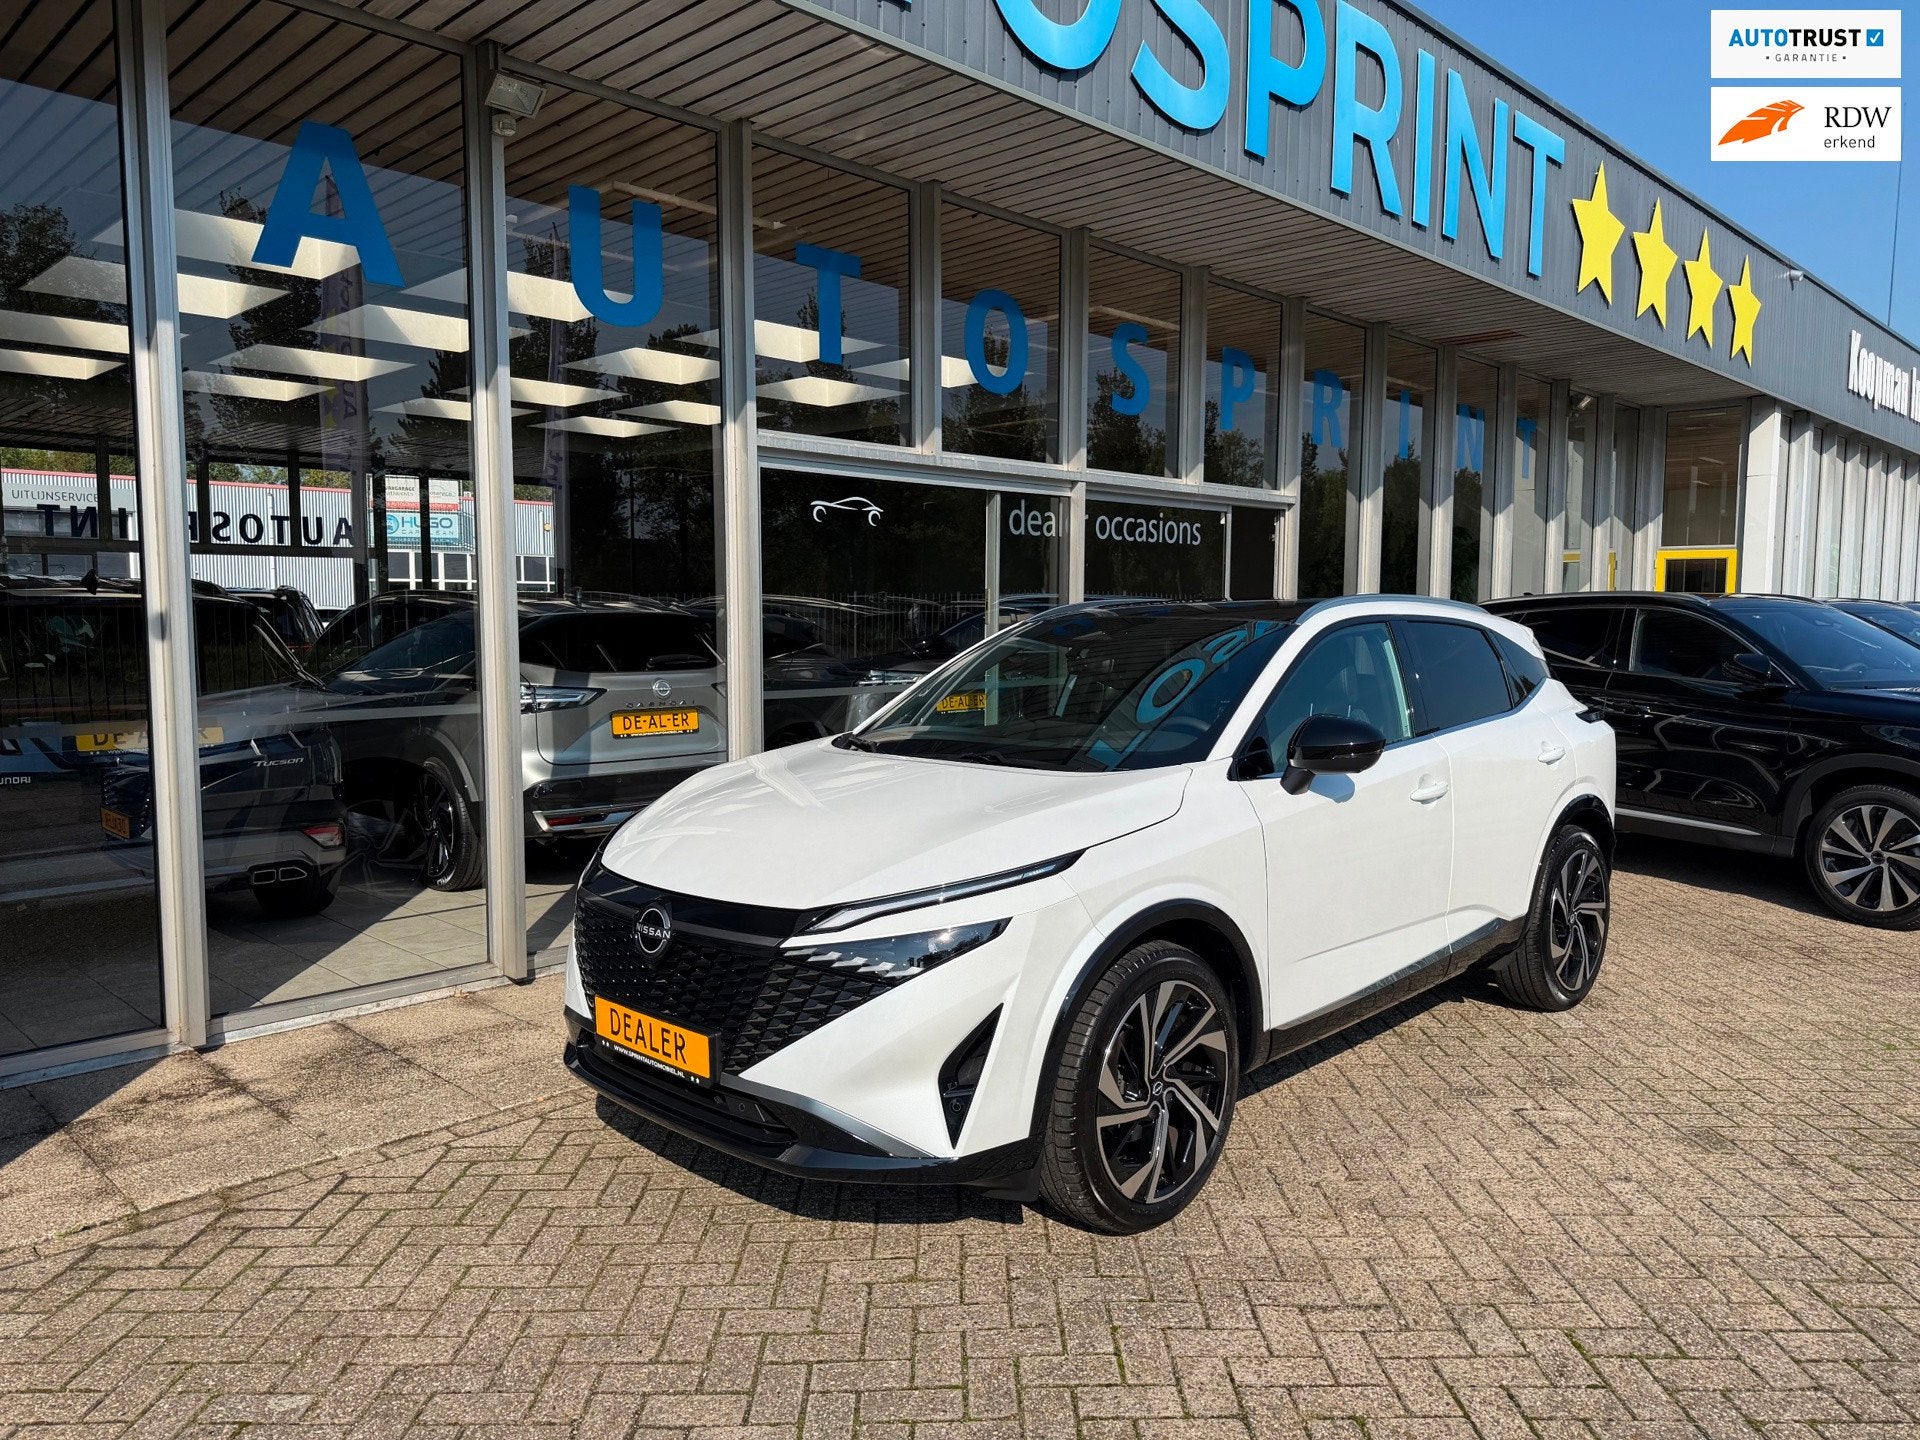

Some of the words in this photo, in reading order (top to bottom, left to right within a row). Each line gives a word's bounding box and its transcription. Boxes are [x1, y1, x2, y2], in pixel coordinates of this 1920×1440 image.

[1848, 329, 1909, 417] Koopman
[1095, 512, 1201, 546] occasions
[622, 712, 690, 731] DE-AL-ER
[635, 922, 671, 939] NISSAN
[610, 1007, 687, 1065] DEALER
